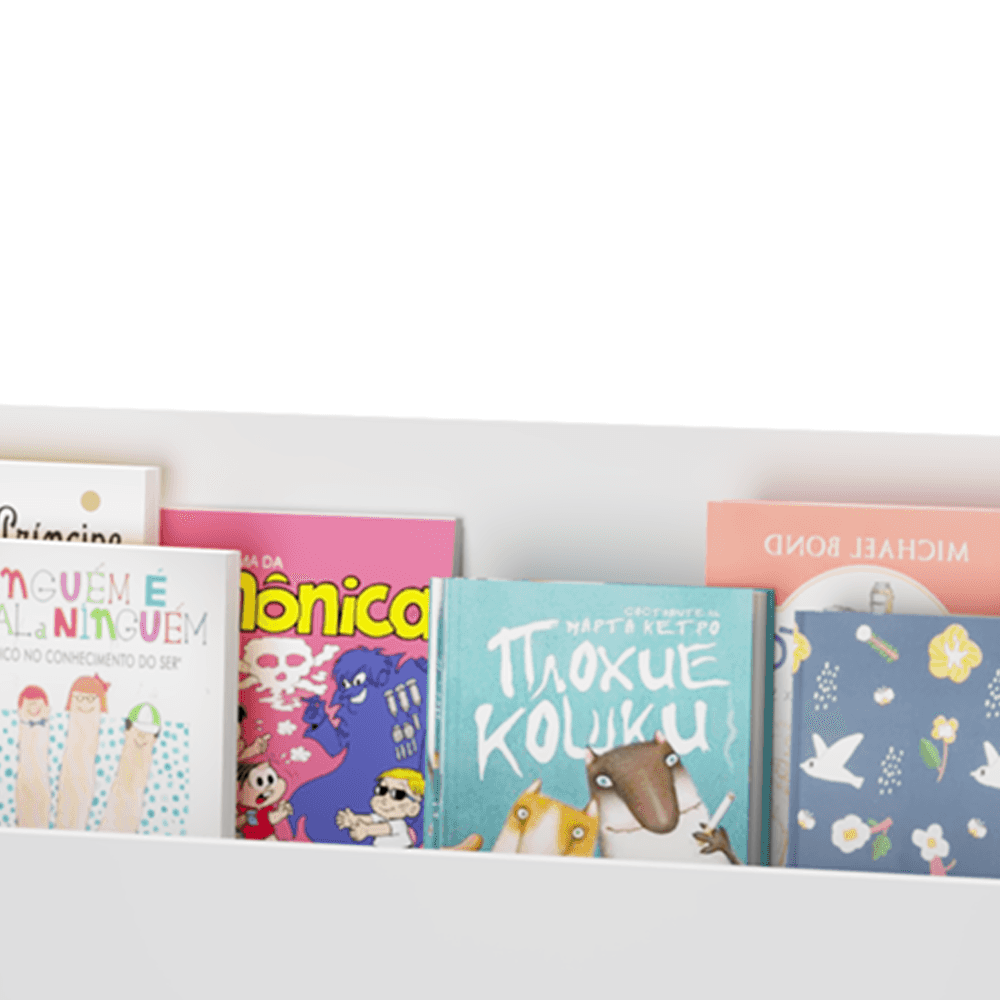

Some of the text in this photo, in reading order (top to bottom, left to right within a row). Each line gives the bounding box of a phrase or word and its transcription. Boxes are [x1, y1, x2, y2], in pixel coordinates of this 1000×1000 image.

[262, 554, 283, 569] DA
[145, 568, 167, 607] É
[24, 649, 43, 663] NO
[45, 650, 136, 668] CONHECIMENTO
[138, 654, 157, 669] DO
